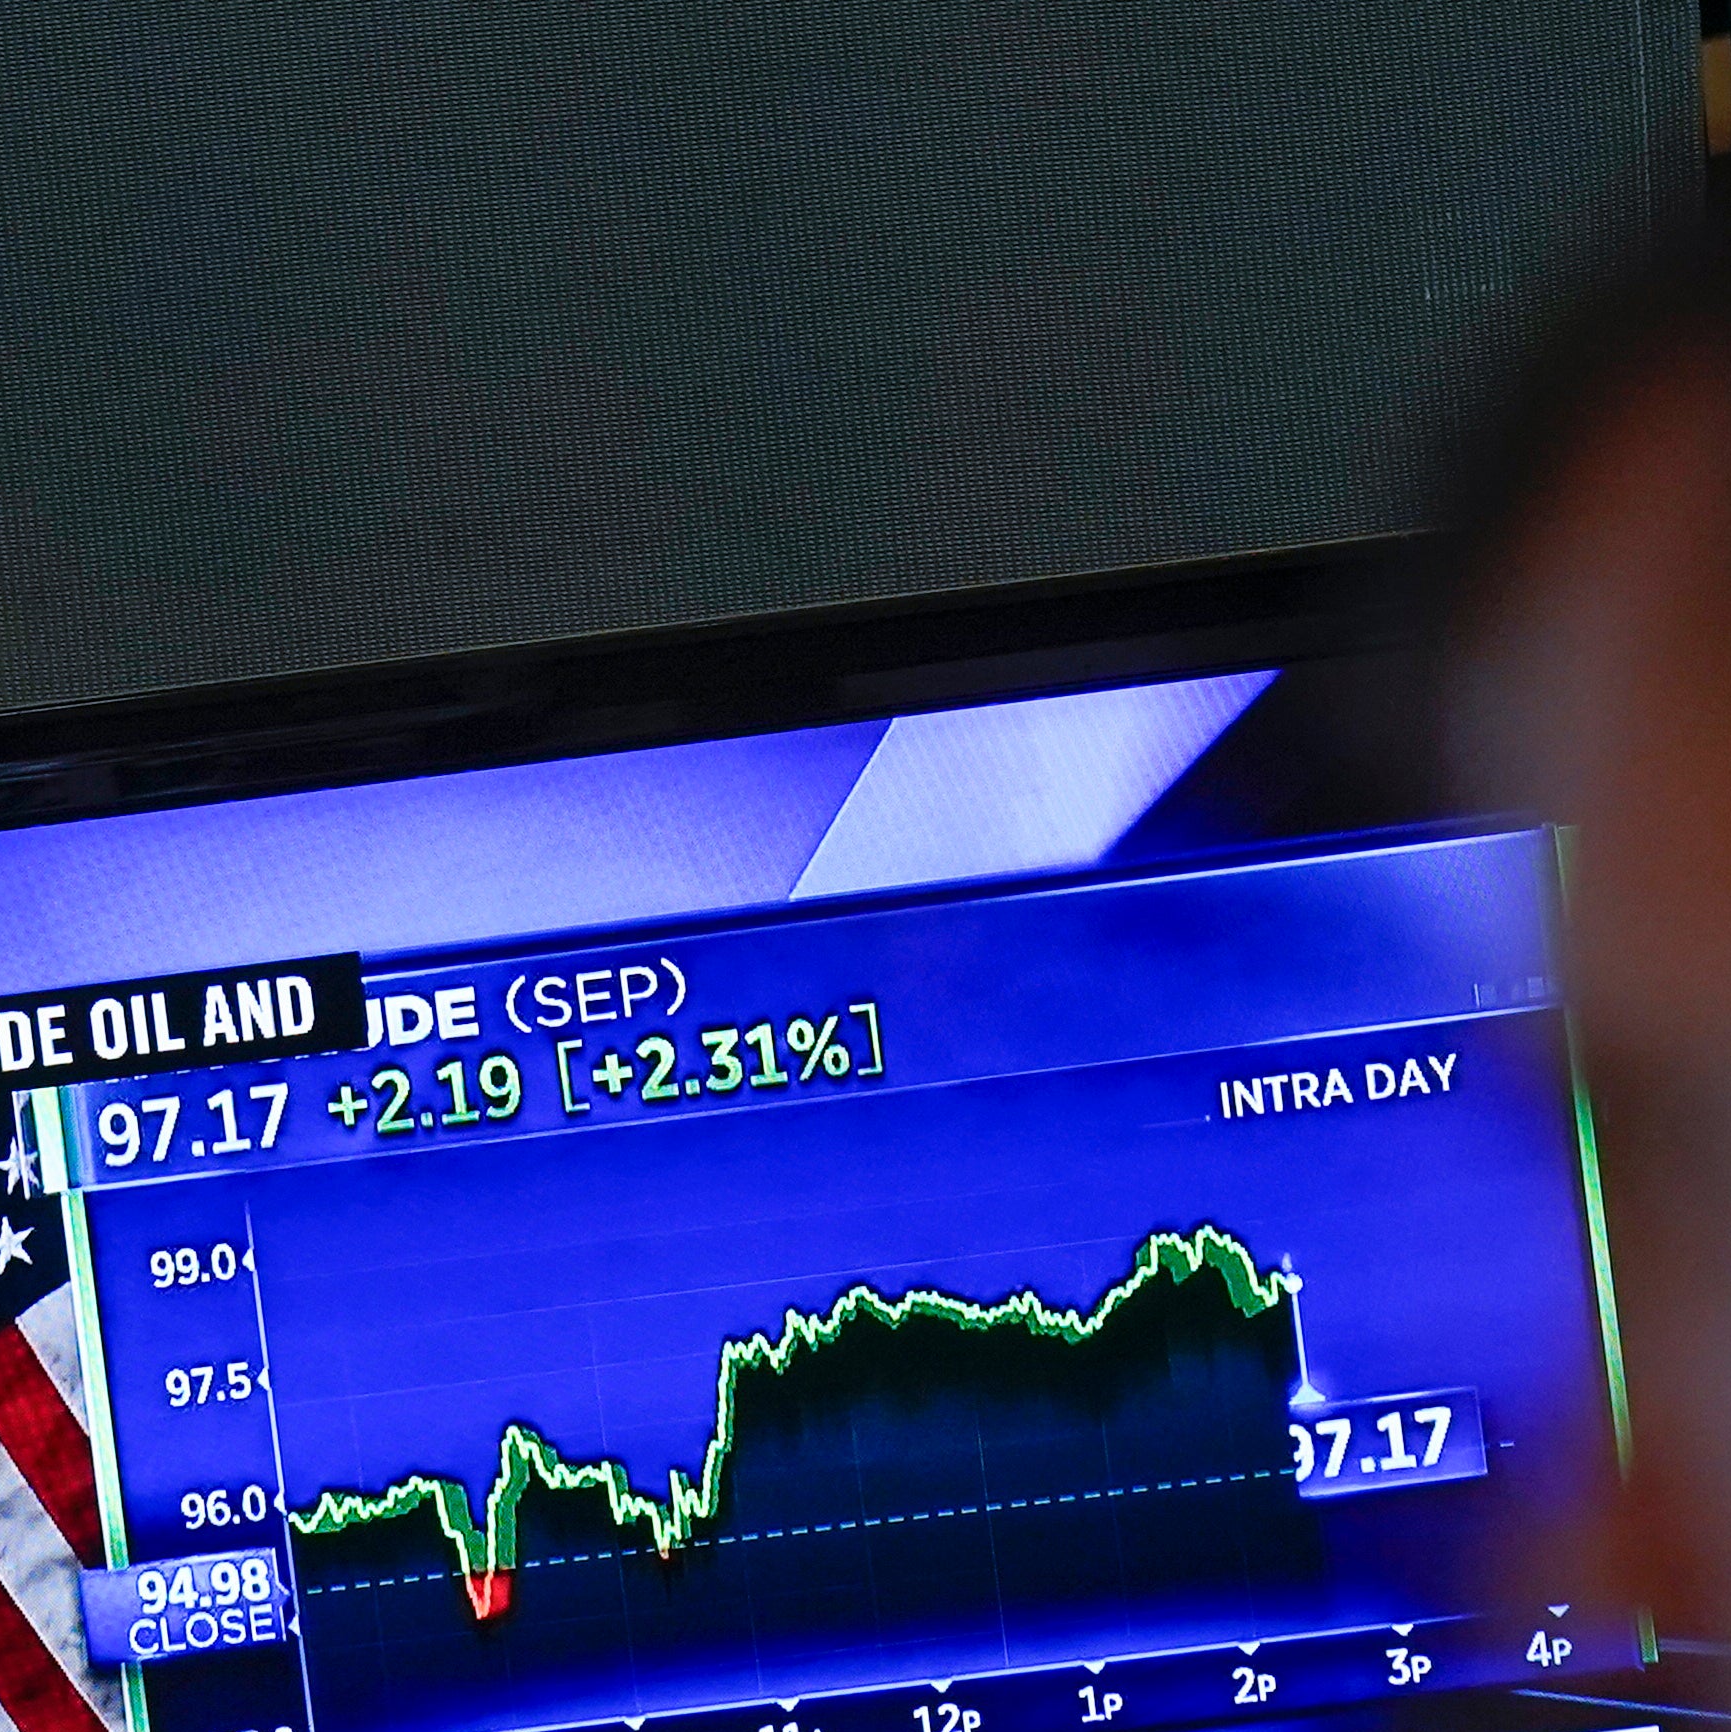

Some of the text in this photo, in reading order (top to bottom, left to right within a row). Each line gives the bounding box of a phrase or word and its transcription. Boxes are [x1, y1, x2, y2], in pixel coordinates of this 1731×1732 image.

[89, 992, 186, 1061] OIL
[202, 974, 315, 1048] AND
[505, 957, 687, 1034] (SEP)
[97, 1002, 884, 1168] 97.17 +2.19 [+2.31%]
[1219, 1052, 1457, 1120] INTRA DAY
[149, 1242, 237, 1289] 99.0
[165, 1362, 251, 1407] 97.5
[1288, 1406, 1452, 1483] 97.17
[180, 1484, 267, 1529] 96.0
[137, 1558, 271, 1614] 94.98
[129, 1604, 277, 1655] CLOSE
[1077, 1685, 1124, 1723] 1P
[1232, 1667, 1277, 1705] 2P
[1386, 1648, 1432, 1685] 3P
[1525, 1630, 1573, 1667] 4P
